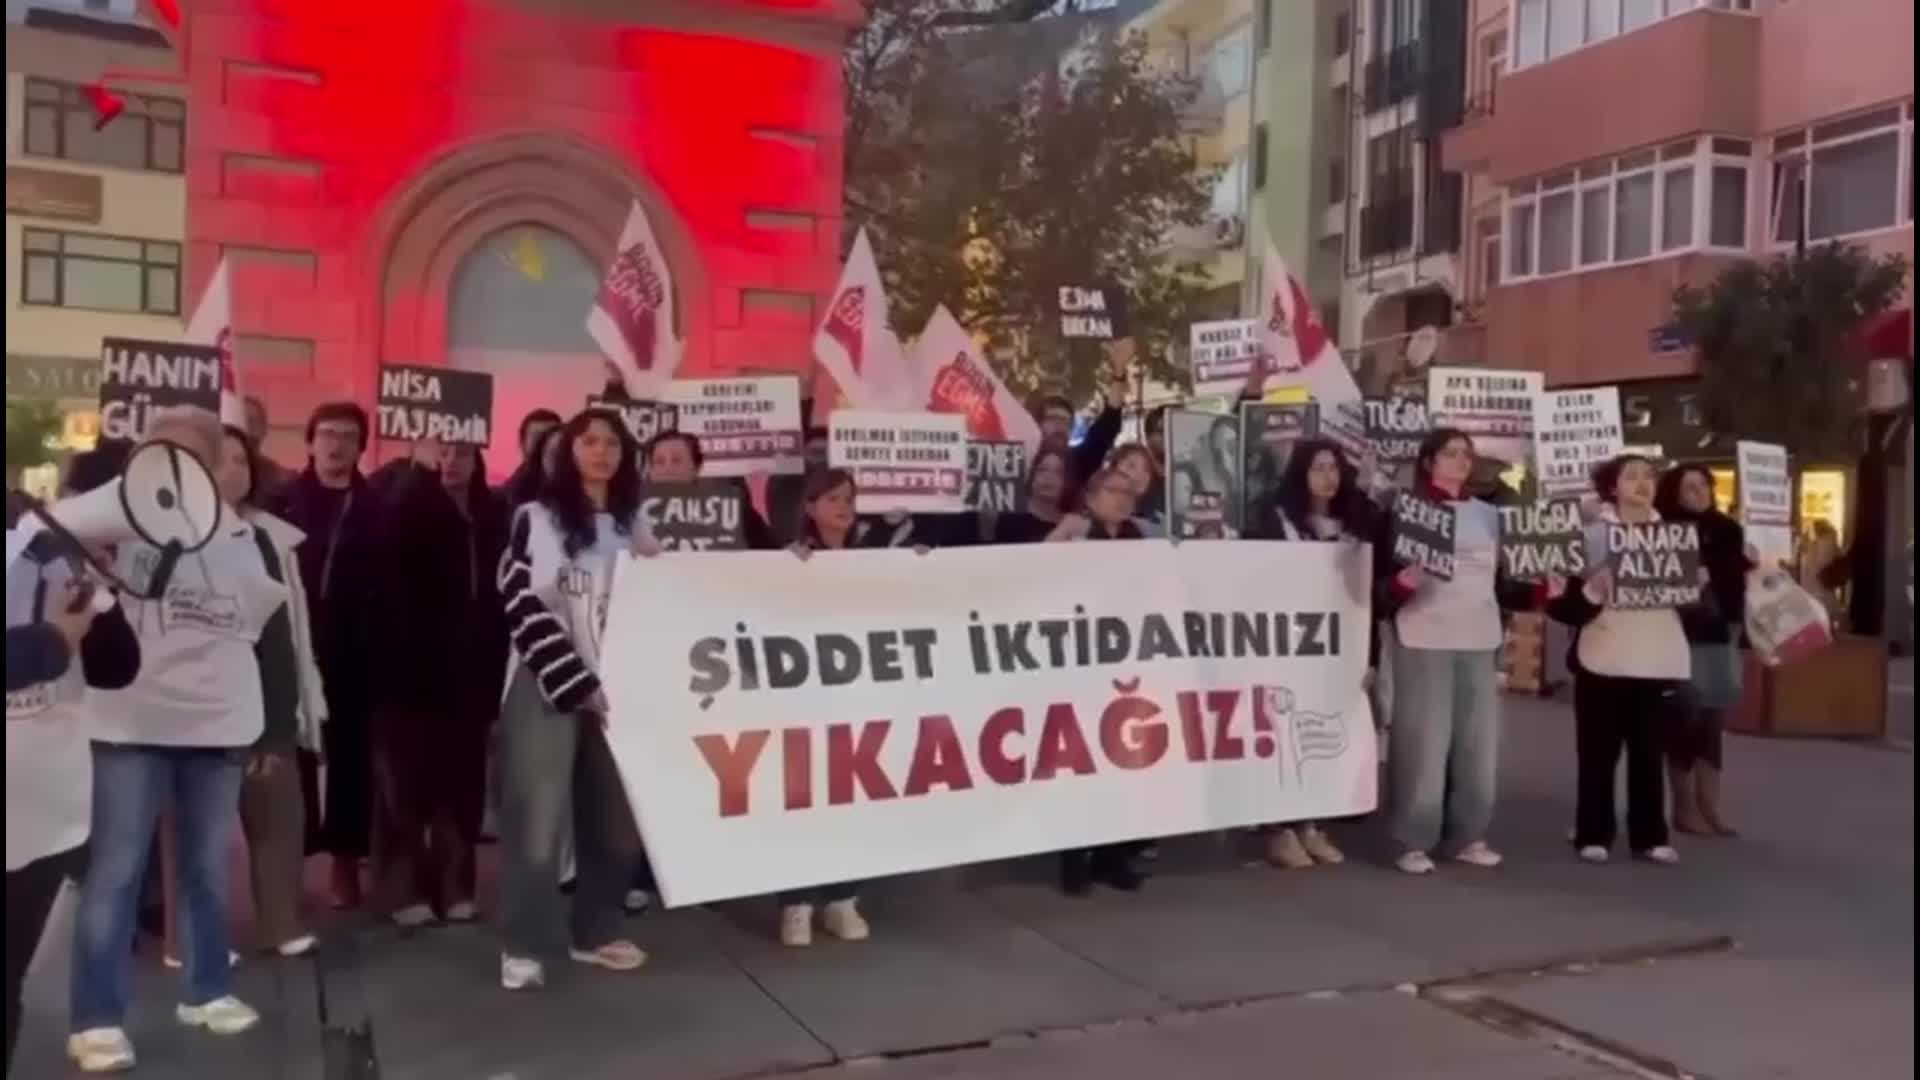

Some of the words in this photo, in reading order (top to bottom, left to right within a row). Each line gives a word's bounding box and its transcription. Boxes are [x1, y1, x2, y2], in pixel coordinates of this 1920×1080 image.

[102, 346, 221, 391] HANIM
[382, 368, 442, 402] NİSA
[1498, 498, 1584, 536] TUĞBA
[1617, 551, 1685, 582] ALYA
[688, 621, 937, 710] ŞİDDET
[967, 603, 1341, 675] İKTİDARINIZI
[692, 675, 1275, 818] YIKACAĞIZ!
